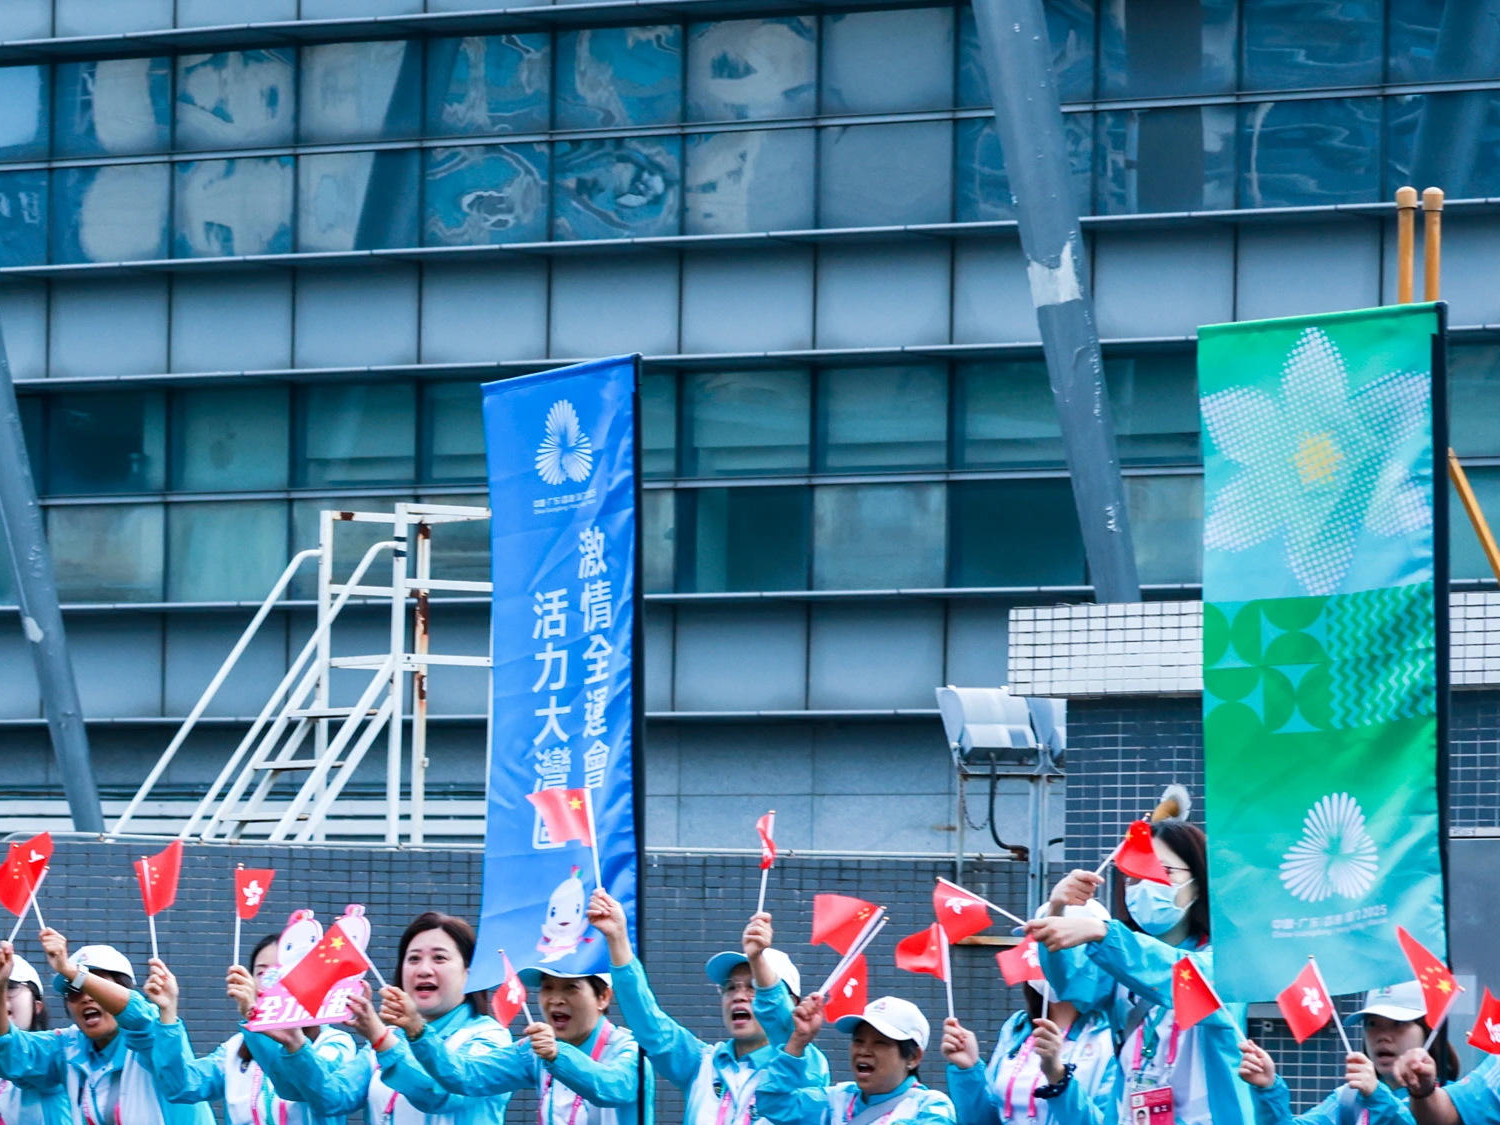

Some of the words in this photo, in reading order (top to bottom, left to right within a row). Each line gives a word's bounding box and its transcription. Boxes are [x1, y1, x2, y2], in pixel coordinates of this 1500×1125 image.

[578, 526, 613, 788] 激情全運會
